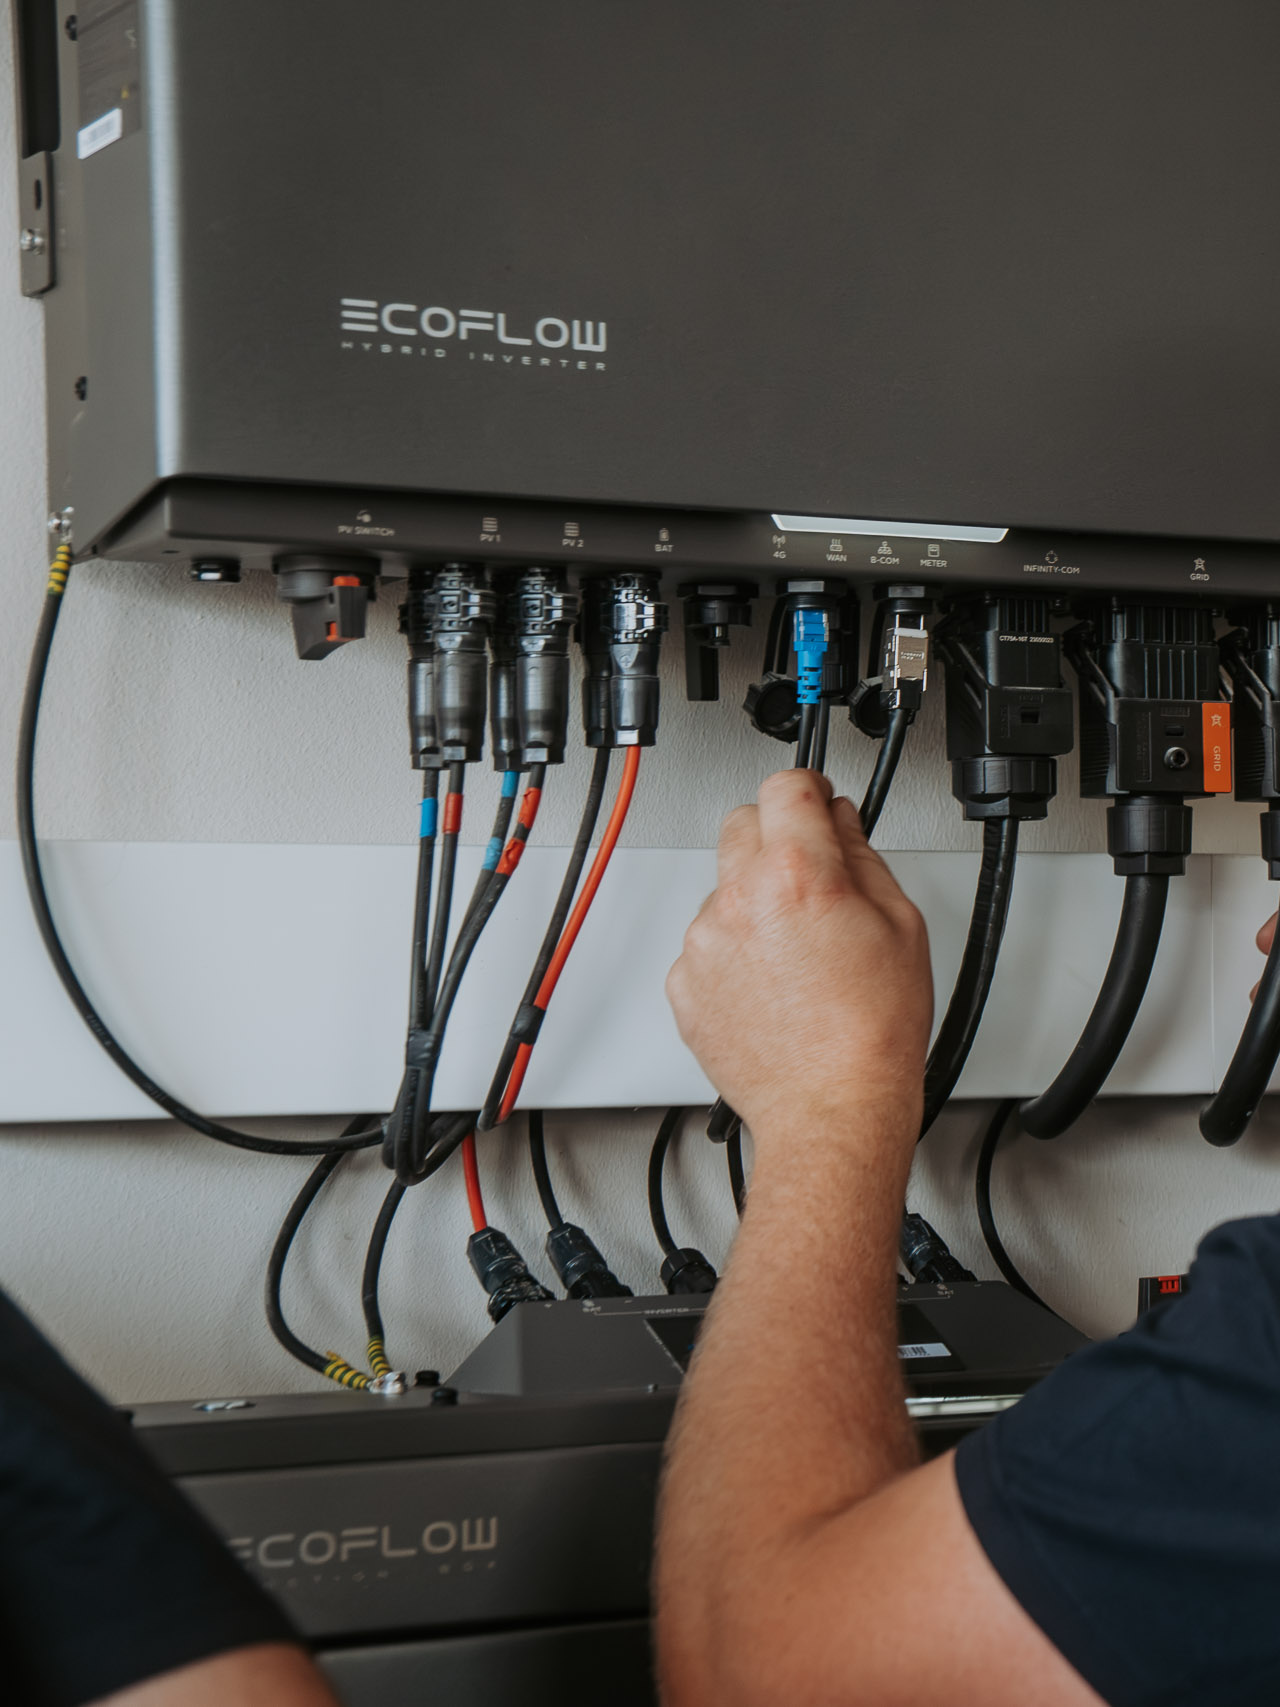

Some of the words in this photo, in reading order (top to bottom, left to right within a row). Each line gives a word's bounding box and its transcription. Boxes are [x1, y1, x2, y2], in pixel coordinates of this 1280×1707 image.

[340, 298, 607, 352] ECOFLOW
[341, 341, 446, 358] HYBRID
[468, 352, 606, 371] INVERTER
[338, 525, 353, 534] PV
[480, 533, 495, 542] PV
[562, 538, 575, 547] PV
[577, 539, 584, 547] 2
[655, 544, 673, 552] BAT
[773, 551, 786, 559] 4G
[826, 553, 847, 562] WAN
[870, 556, 899, 565] B-COM
[920, 559, 947, 568] METER
[1023, 564, 1080, 574] INFINITY-COM
[1190, 573, 1210, 581] GRID
[1213, 745, 1222, 772] GRID
